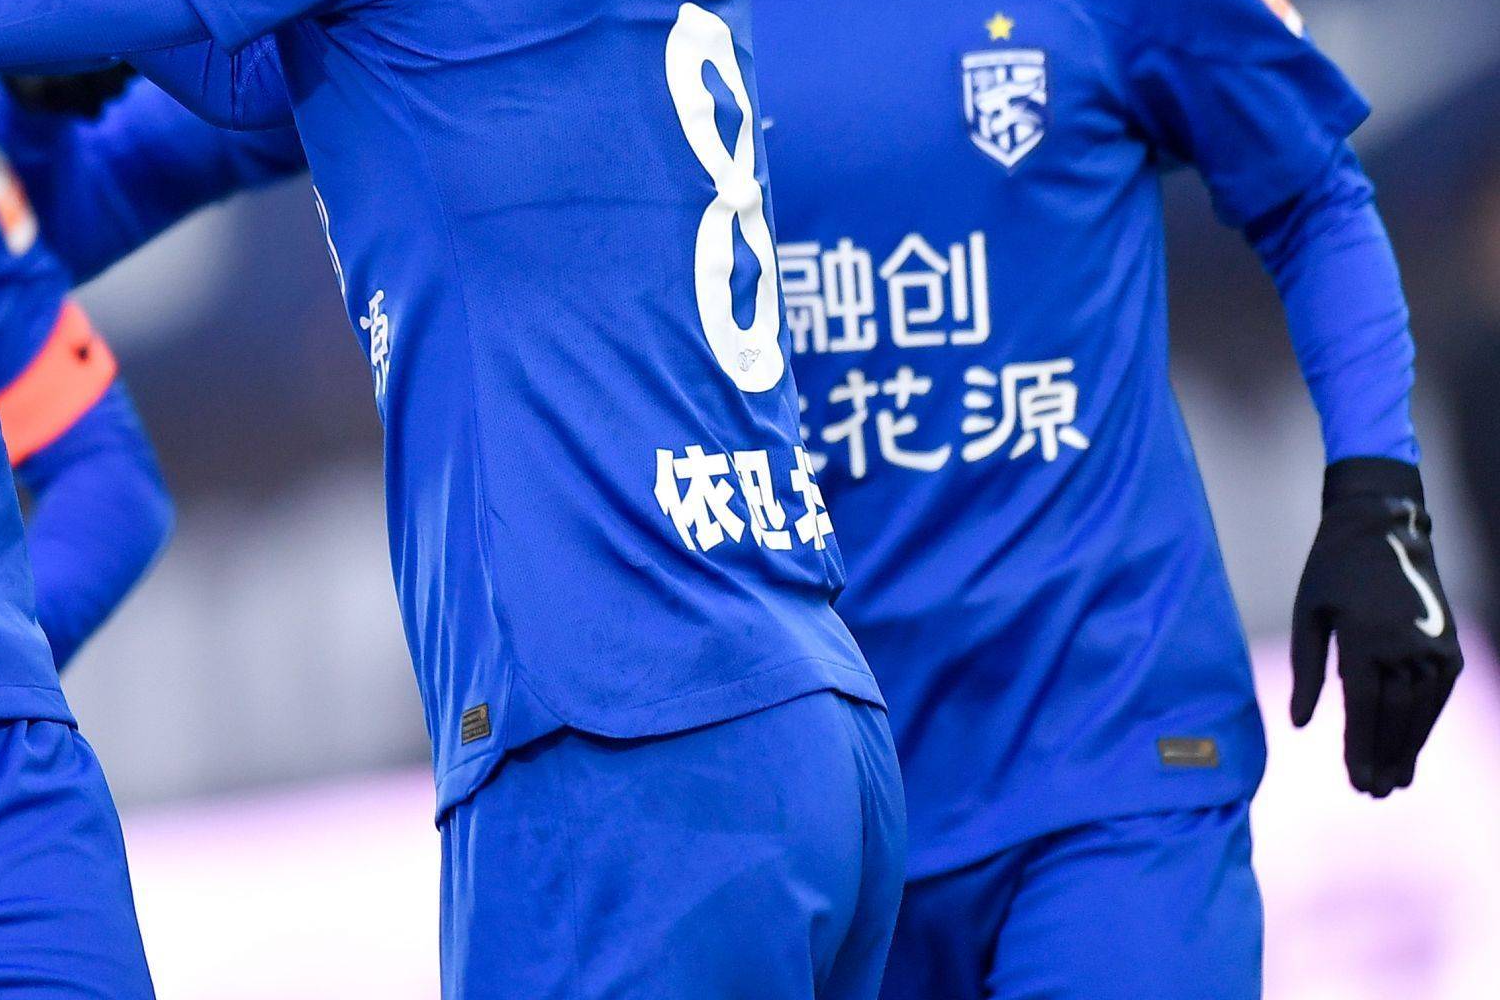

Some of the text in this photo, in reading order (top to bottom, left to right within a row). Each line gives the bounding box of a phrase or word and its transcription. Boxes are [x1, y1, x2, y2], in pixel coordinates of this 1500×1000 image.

[664, 2, 786, 394] 8
[775, 231, 991, 354] 融创
[799, 357, 1090, 479] 花源
